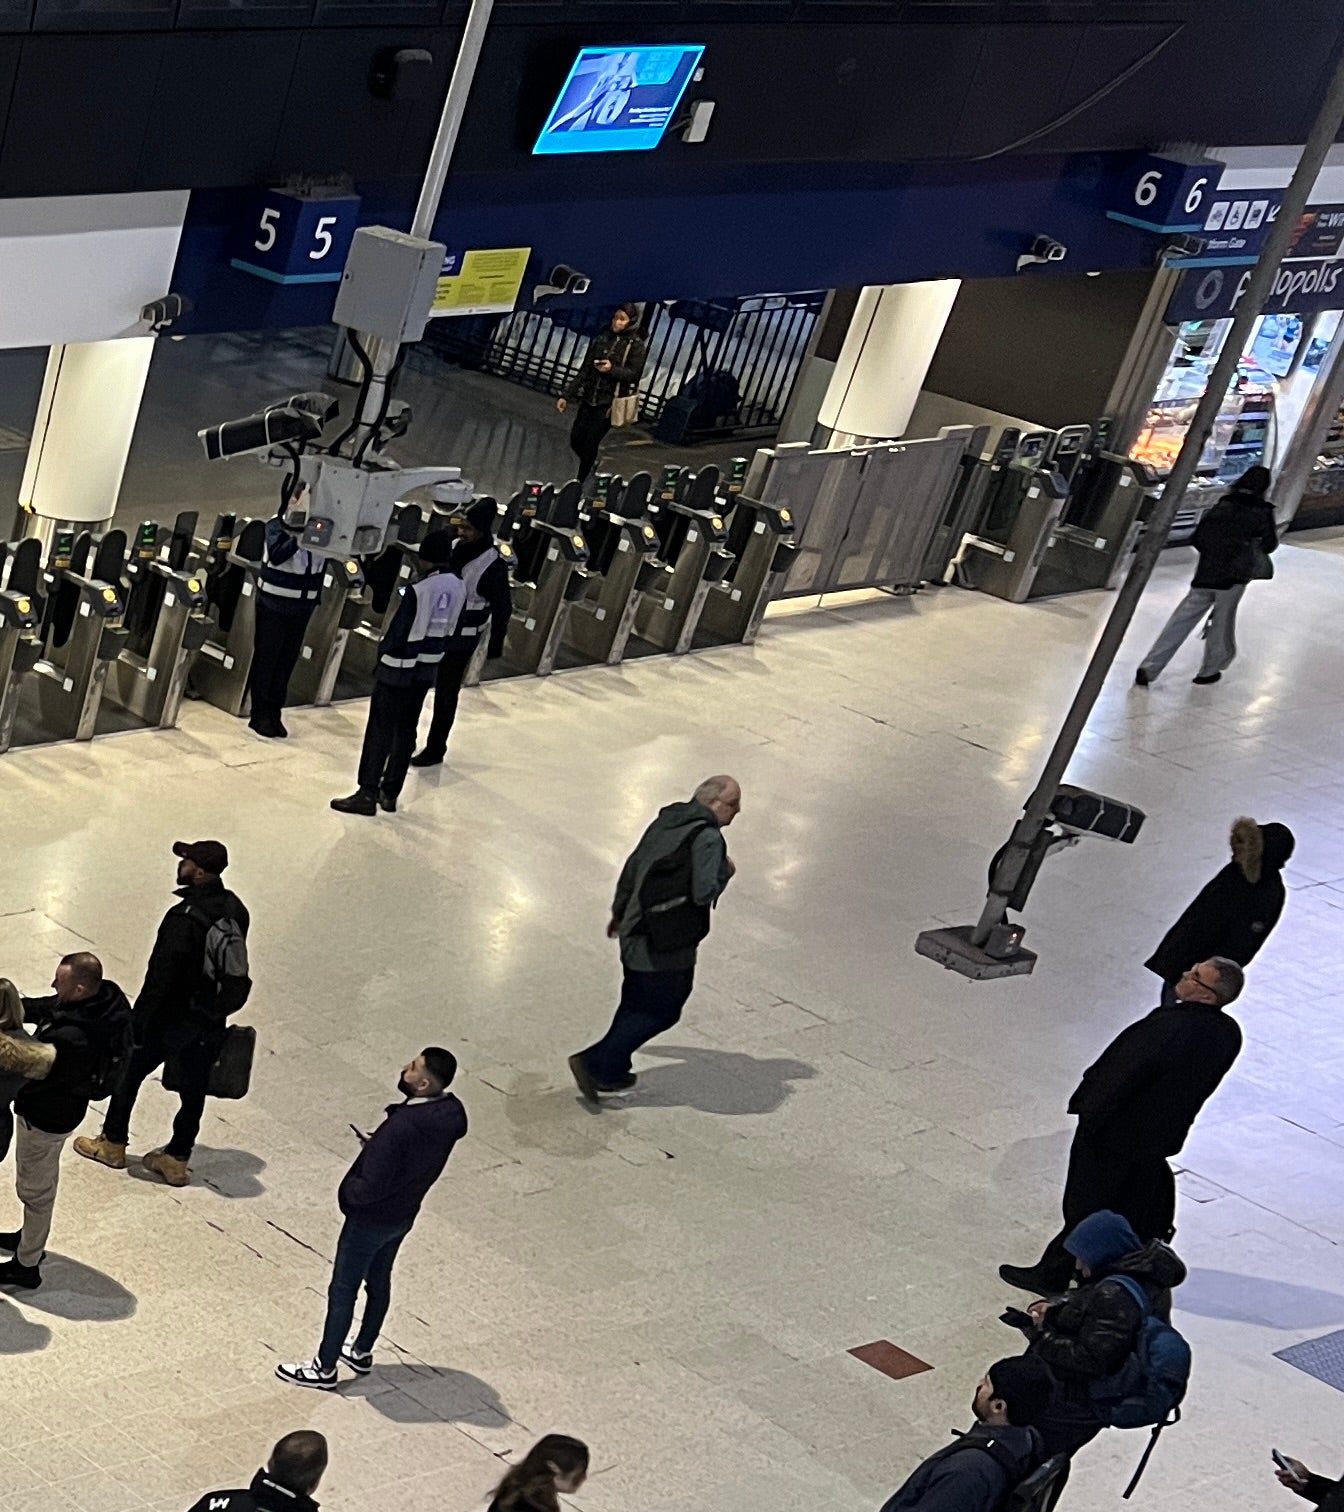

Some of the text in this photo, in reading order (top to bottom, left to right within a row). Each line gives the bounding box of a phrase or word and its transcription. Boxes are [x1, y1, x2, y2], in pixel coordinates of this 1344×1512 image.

[1134, 170, 1163, 206] 6
[1184, 178, 1208, 213] 6
[254, 207, 280, 252] 5
[309, 216, 337, 259] 5
